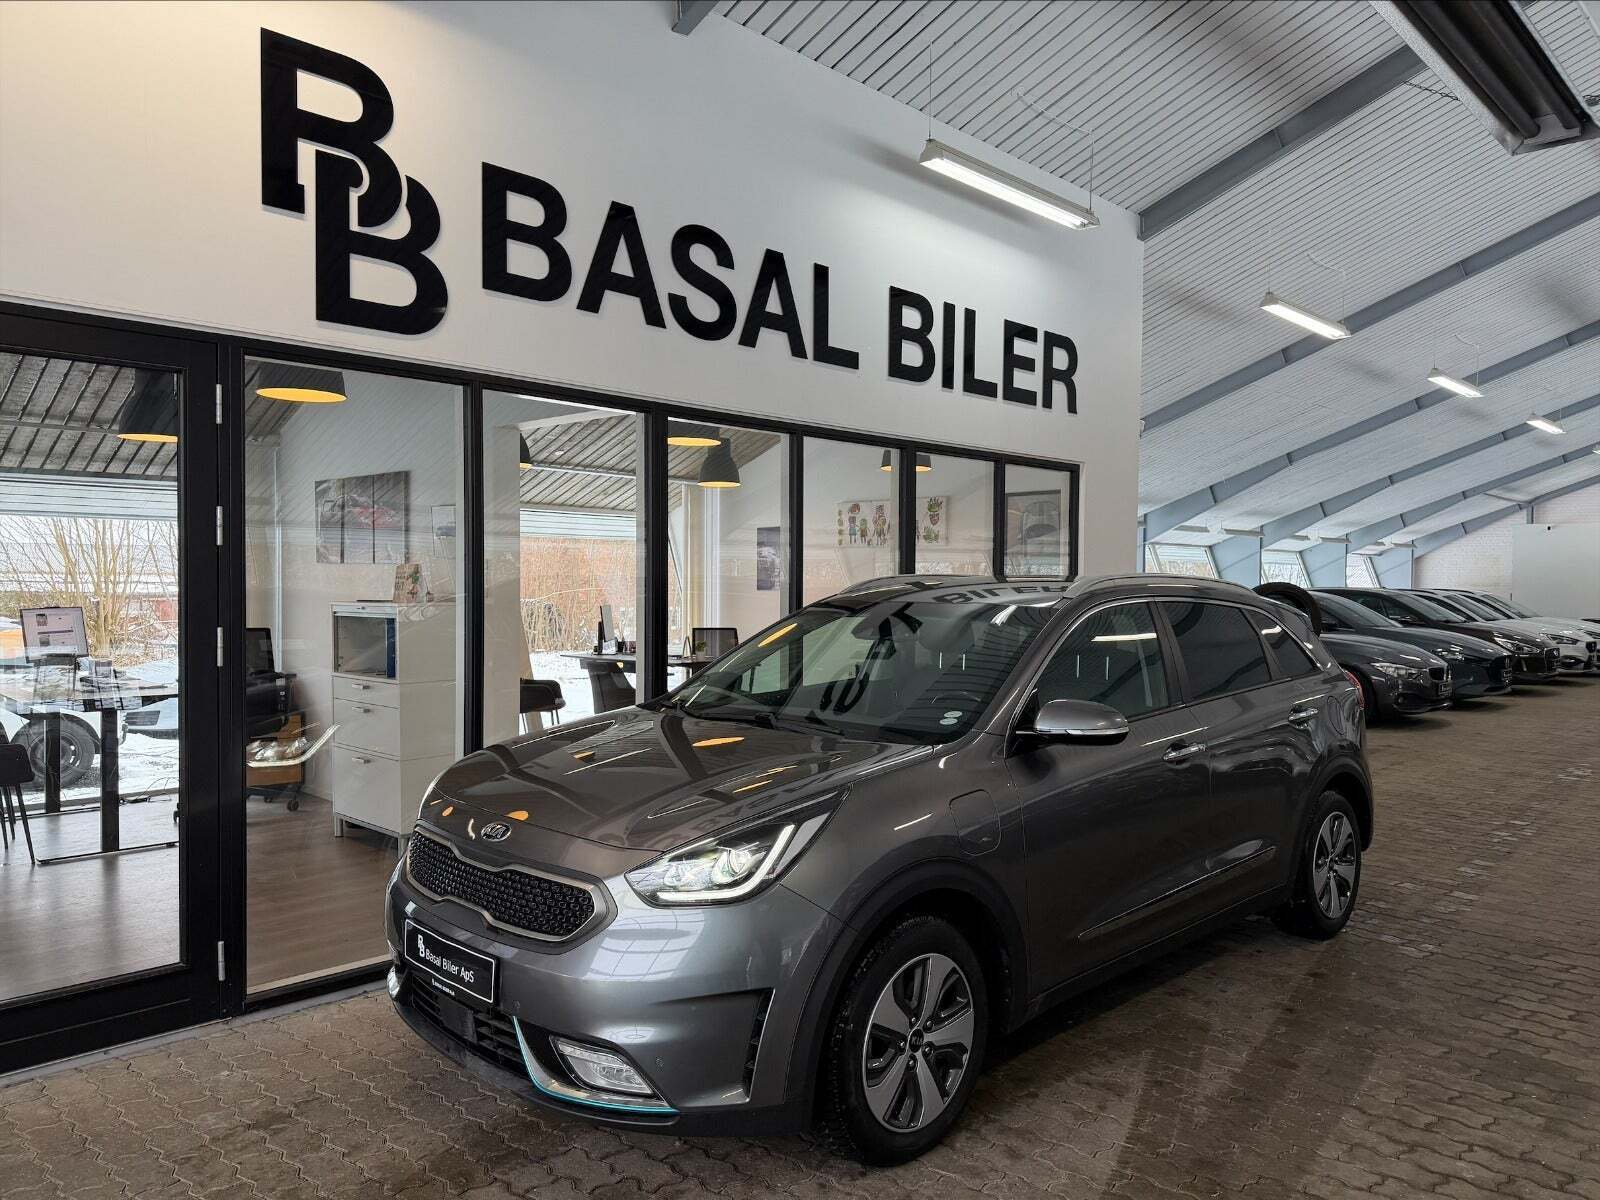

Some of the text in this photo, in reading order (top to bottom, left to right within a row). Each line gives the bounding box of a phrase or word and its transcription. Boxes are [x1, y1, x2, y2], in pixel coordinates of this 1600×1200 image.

[482, 161, 1079, 415] BASAL BILER
[425, 948, 475, 983] Basal Biler ApS
